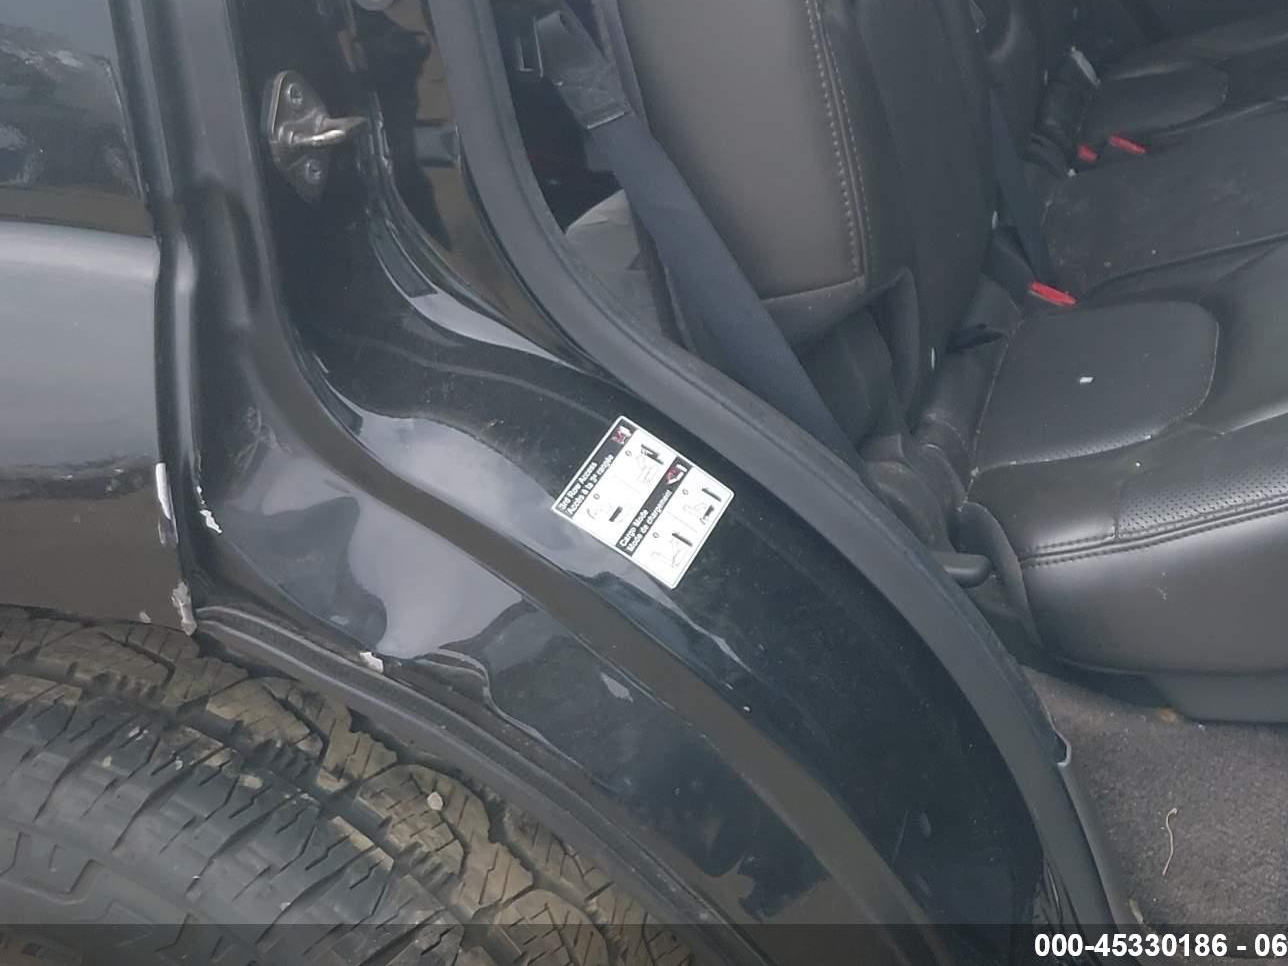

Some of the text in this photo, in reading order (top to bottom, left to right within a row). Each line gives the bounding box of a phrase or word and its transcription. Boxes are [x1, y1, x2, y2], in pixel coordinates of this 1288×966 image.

[558, 496, 571, 511] 3rd
[566, 482, 581, 498] Row
[578, 461, 598, 484] Access
[619, 509, 648, 547] Cargo Mode
[627, 533, 643, 552] Mode
[640, 524, 649, 534] de
[646, 489, 672, 524] chargement
